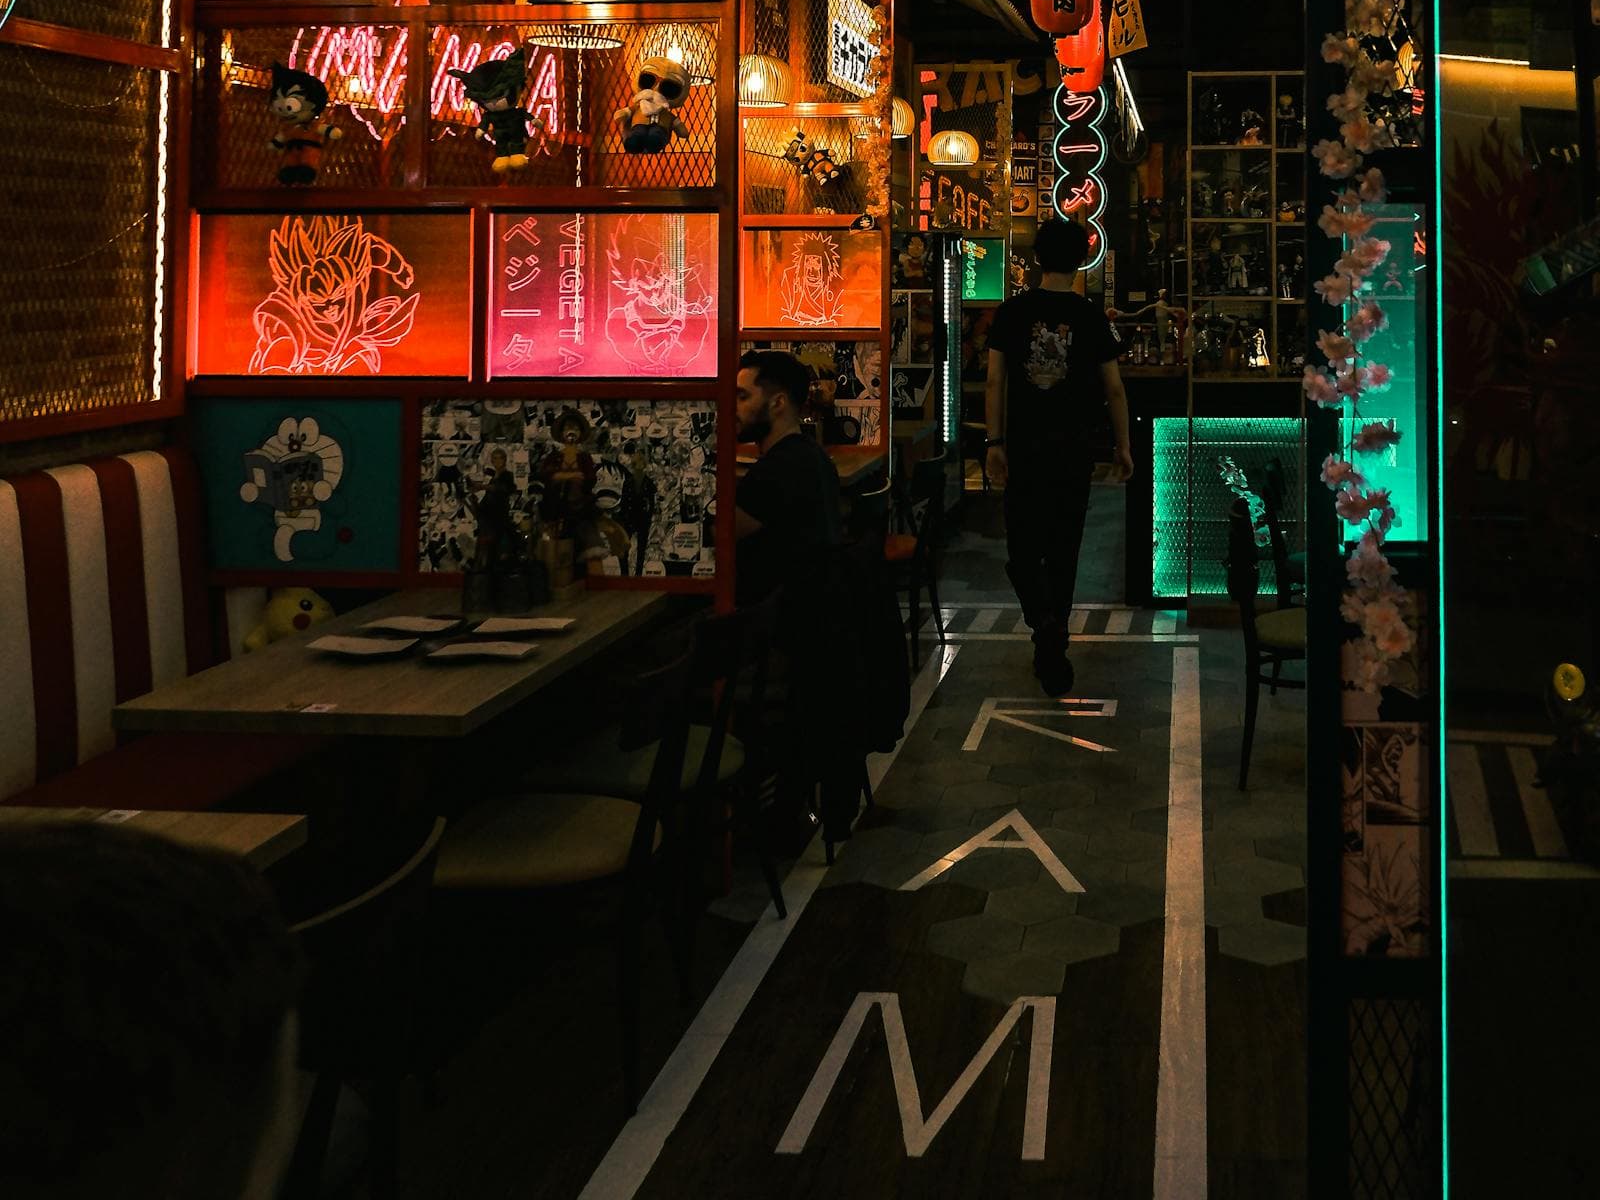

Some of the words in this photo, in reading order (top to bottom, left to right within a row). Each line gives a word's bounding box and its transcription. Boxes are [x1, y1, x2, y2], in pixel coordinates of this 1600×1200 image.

[1058, 90, 1100, 246] ラーメ
[502, 216, 542, 371] ベジータ
[558, 216, 586, 373] VEGETA
